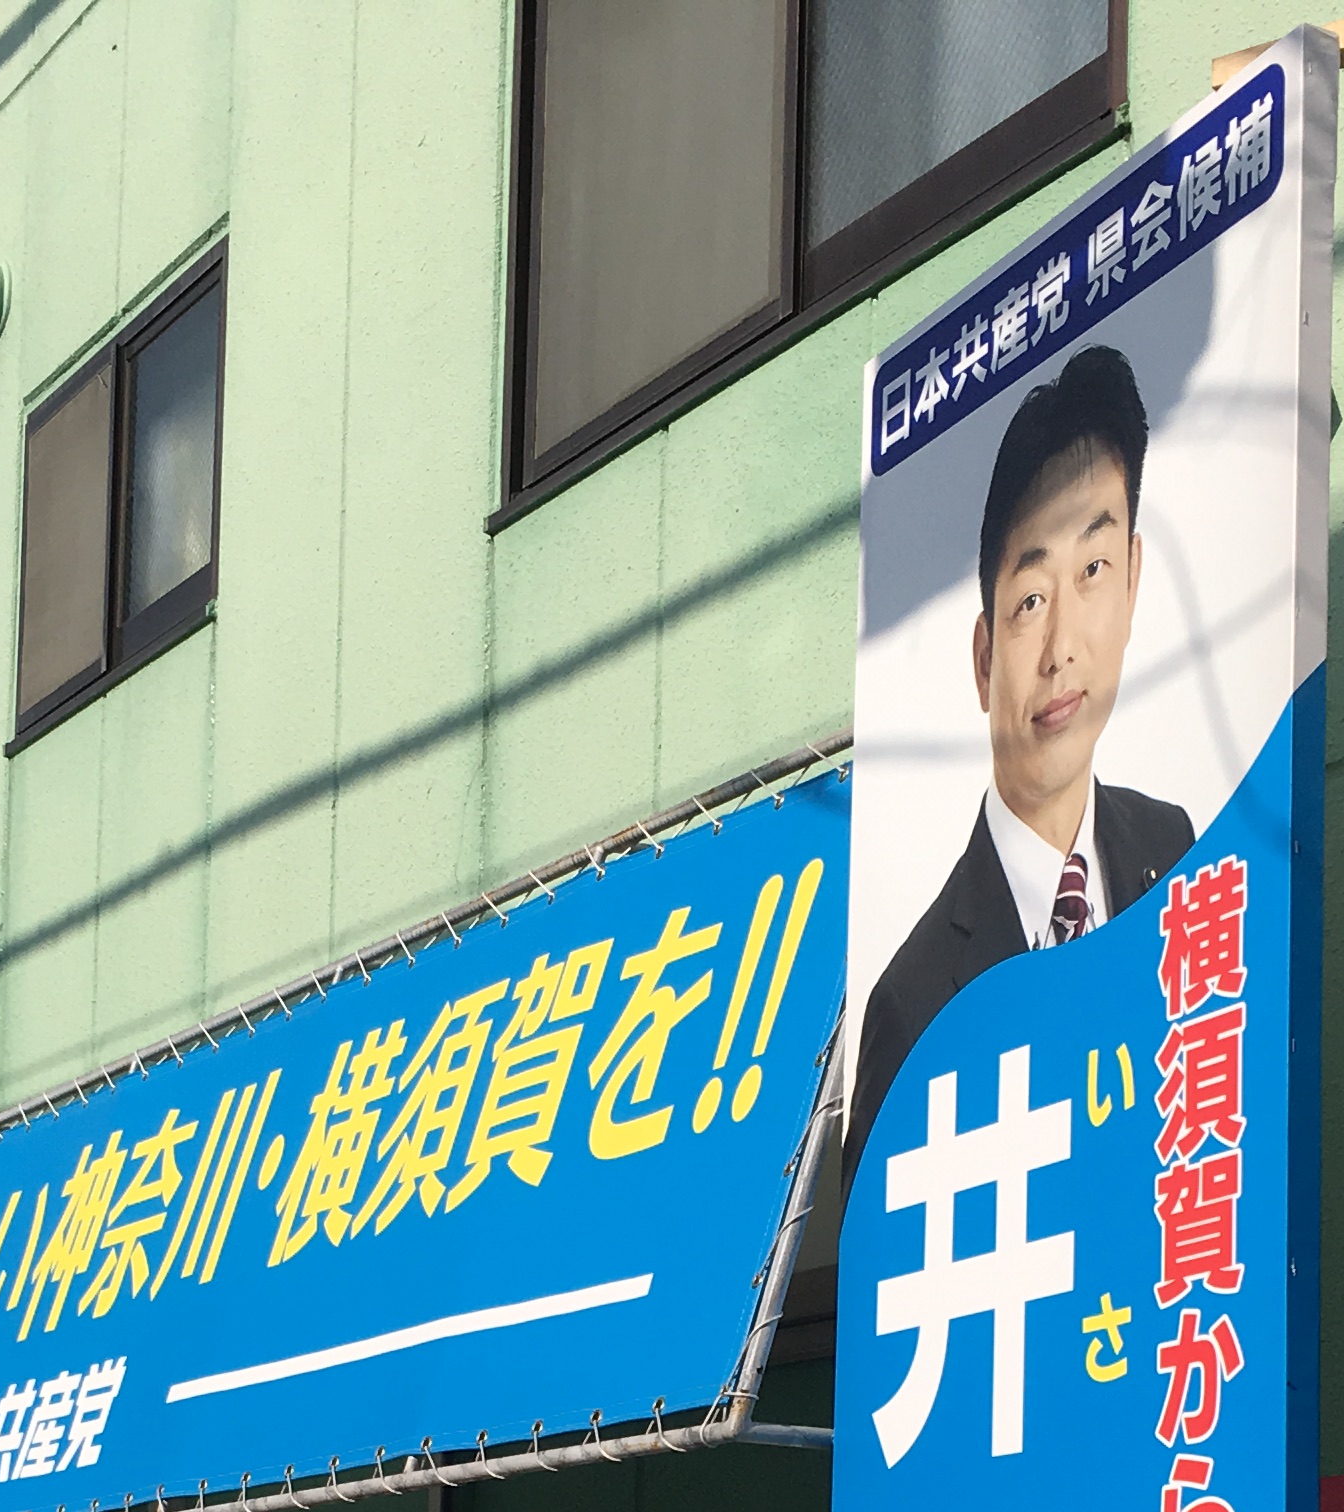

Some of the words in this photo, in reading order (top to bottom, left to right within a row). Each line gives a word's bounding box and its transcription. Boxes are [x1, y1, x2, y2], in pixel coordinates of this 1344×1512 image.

[878, 252, 1072, 457] 日本共産党
[1084, 91, 1275, 305] 県会候補
